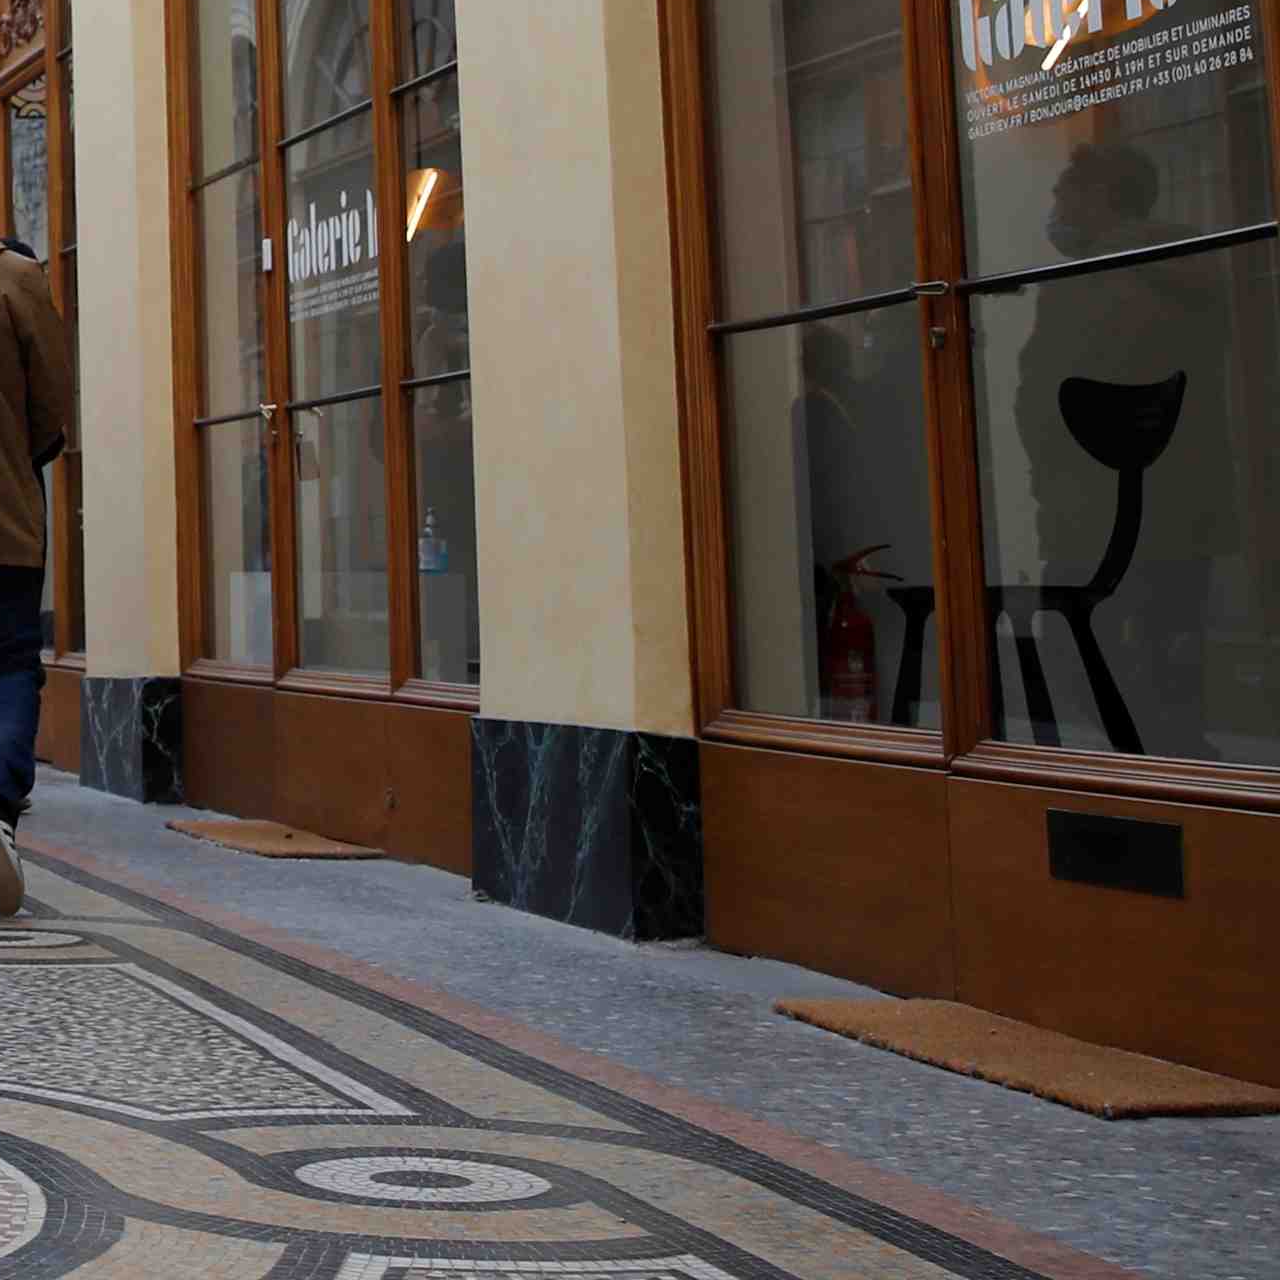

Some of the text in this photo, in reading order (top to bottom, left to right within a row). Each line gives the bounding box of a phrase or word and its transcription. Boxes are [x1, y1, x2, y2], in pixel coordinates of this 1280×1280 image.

[1008, 94, 1020, 110] LE
[1023, 84, 1060, 106] SAMEDI
[1063, 78, 1077, 94] DE
[1080, 68, 1111, 89] 14H30
[1114, 61, 1122, 78] À
[1125, 58, 1144, 76] 19H
[1148, 52, 1161, 69] ET
[1165, 44, 1188, 63] SUR
[1192, 25, 1252, 55] DEMANDE
[1055, 50, 1105, 77] CRÉATRICE
[1106, 45, 1121, 61] DE
[1122, 30, 1169, 57] MOBILIER
[1171, 25, 1184, 41] ET
[1186, 5, 1250, 37] LUMINAIRES
[1209, 55, 1222, 71] 26
[1224, 50, 1237, 67] 28
[1240, 46, 1254, 63] 84
[287, 190, 361, 283] Galerie
